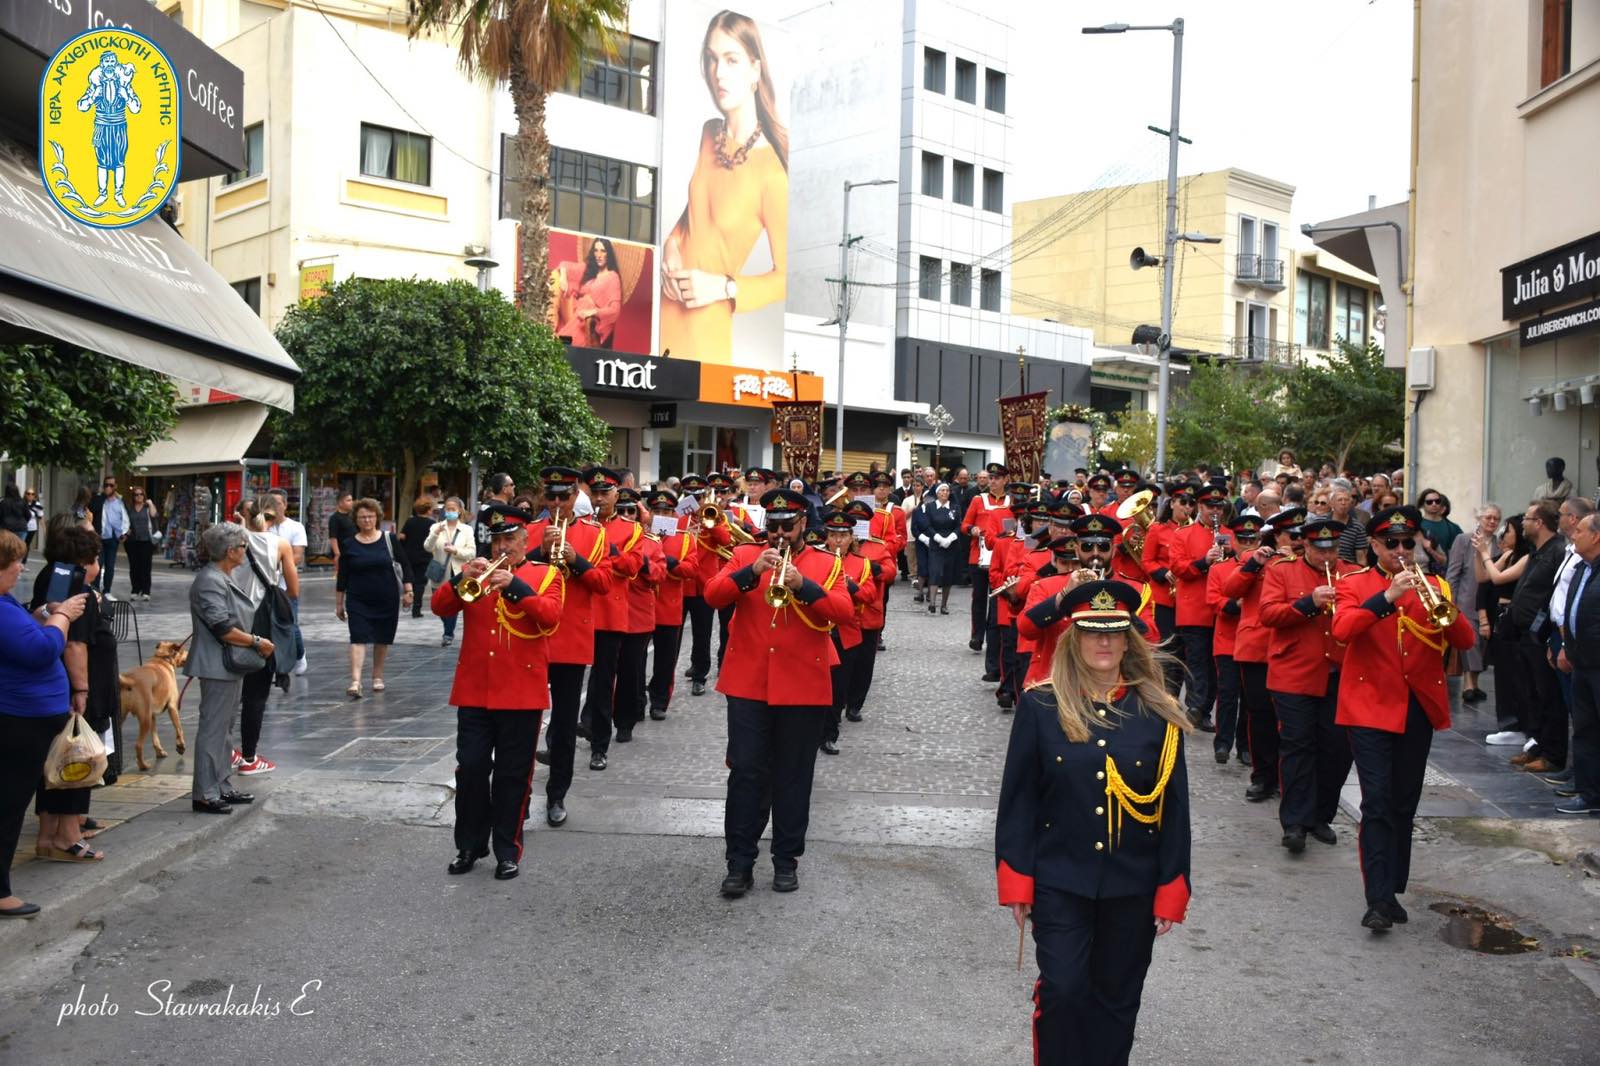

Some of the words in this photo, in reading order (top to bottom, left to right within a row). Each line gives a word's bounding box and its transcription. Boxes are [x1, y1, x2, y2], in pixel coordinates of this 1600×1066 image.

[187, 68, 235, 129] Coffee
[1513, 268, 1550, 305] Julia
[1526, 307, 1600, 339] JULIABERGOVICH.CO
[596, 358, 657, 390] mat
